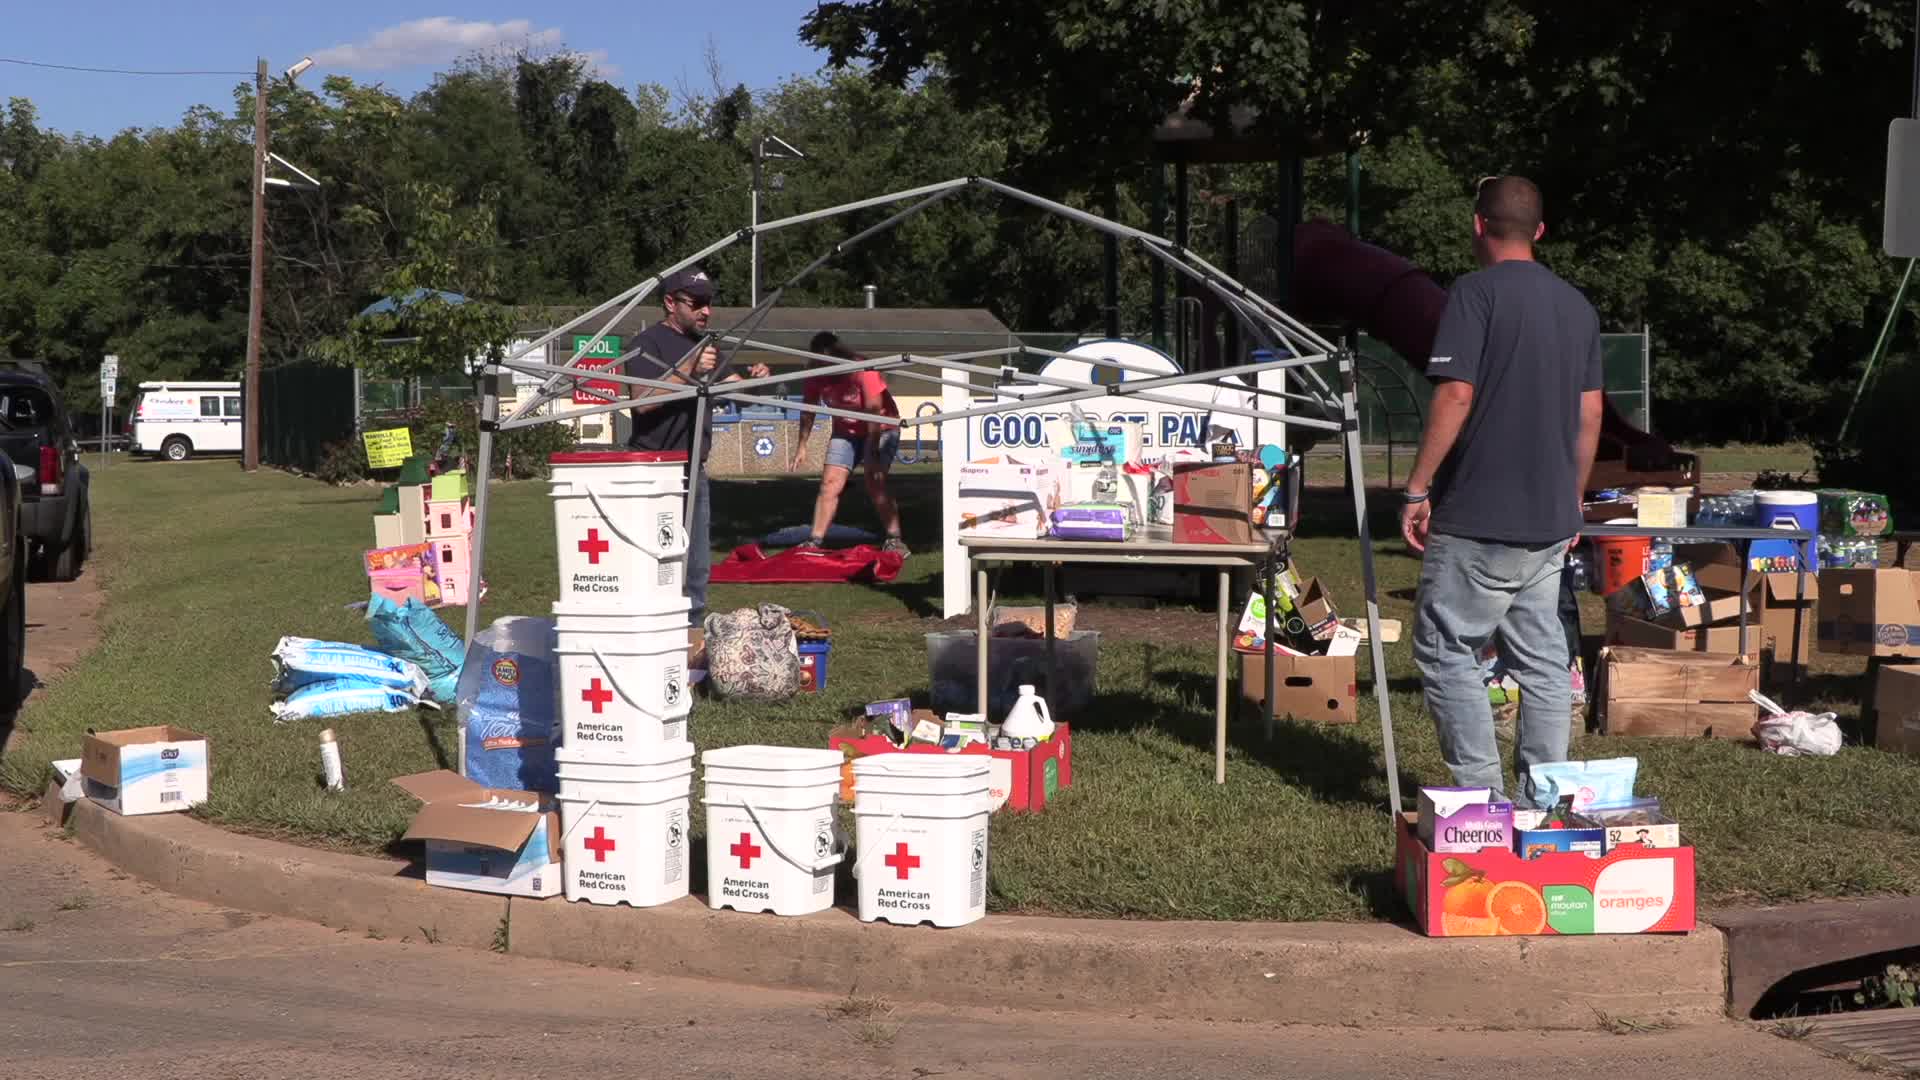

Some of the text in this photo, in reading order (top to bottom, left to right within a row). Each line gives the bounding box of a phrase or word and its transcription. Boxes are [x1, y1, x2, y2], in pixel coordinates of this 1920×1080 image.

[981, 412, 1100, 447] COO
[573, 573, 619, 583] American
[572, 583, 620, 592] Red Cross
[390, 694, 406, 708] 40
[576, 722, 623, 732] American
[577, 731, 624, 742] Red Cross
[1444, 826, 1503, 843] Cheerios
[1609, 830, 1622, 843] 52
[579, 869, 626, 881] American
[579, 879, 627, 891] Red Cross
[723, 877, 769, 889] American
[722, 887, 770, 899] Red Cross
[878, 888, 930, 899] American
[878, 898, 931, 910] Red Cross
[1600, 893, 1664, 910] oranges
